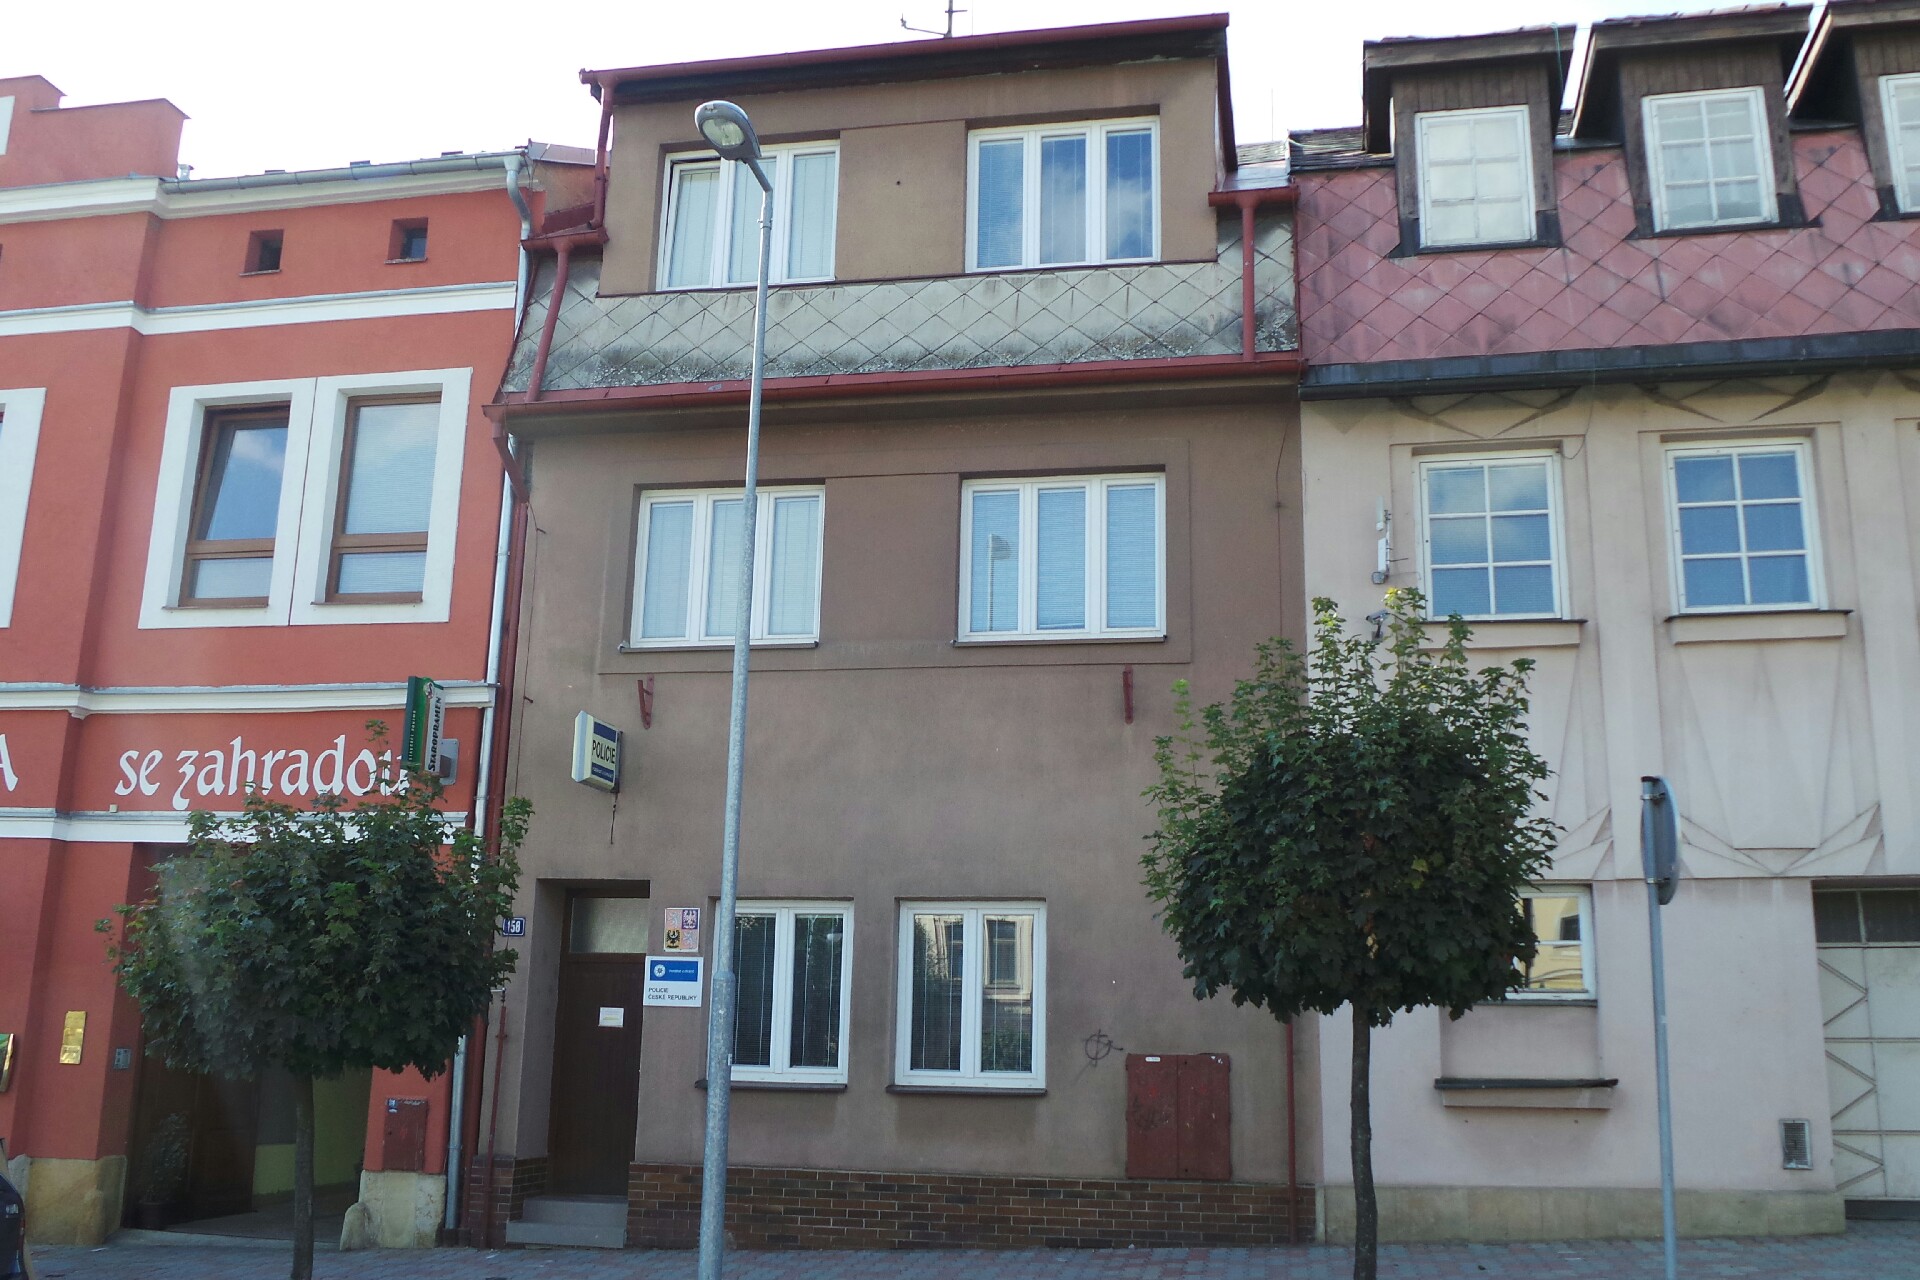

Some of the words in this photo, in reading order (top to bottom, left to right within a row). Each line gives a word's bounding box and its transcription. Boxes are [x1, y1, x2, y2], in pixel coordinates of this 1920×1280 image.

[428, 696, 442, 772] STAROPRAMEN
[592, 739, 616, 764] POLICIE
[114, 749, 163, 796] se
[172, 734, 410, 811] zahradou
[507, 920, 521, 933] 158
